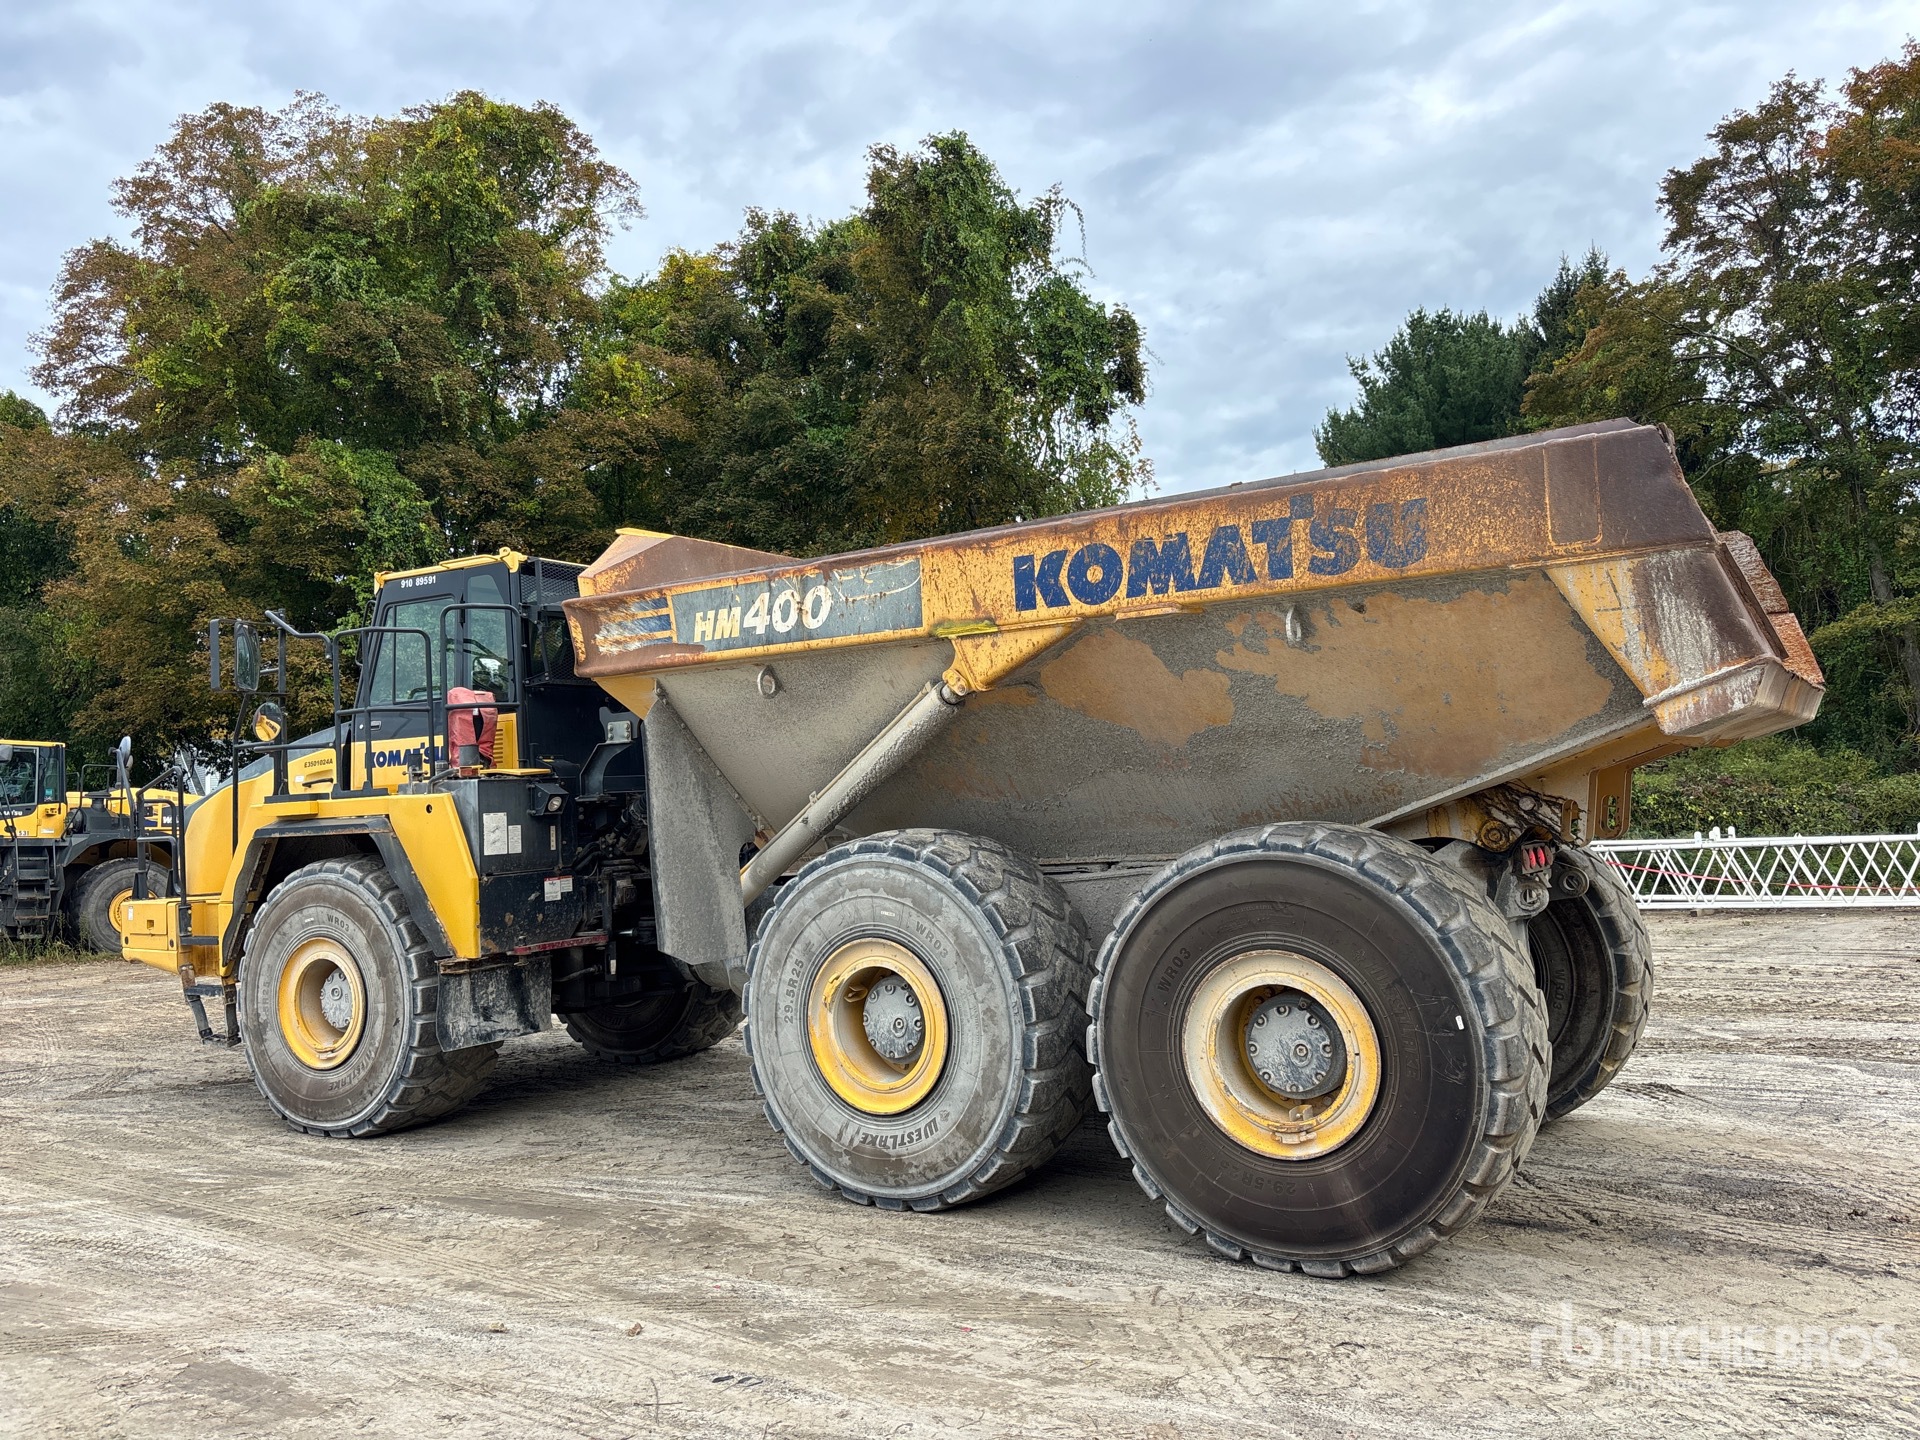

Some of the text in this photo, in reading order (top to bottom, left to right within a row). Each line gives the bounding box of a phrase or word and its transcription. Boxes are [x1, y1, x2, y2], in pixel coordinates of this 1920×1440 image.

[1013, 493, 1428, 612] KOMATSU
[400, 575, 436, 588] 910 89591
[693, 584, 835, 643] HM400
[915, 920, 949, 959] WR03
[783, 958, 804, 1025] 29.5R25
[1156, 947, 1192, 993] WR03
[859, 1116, 939, 1150] WESTLAKE
